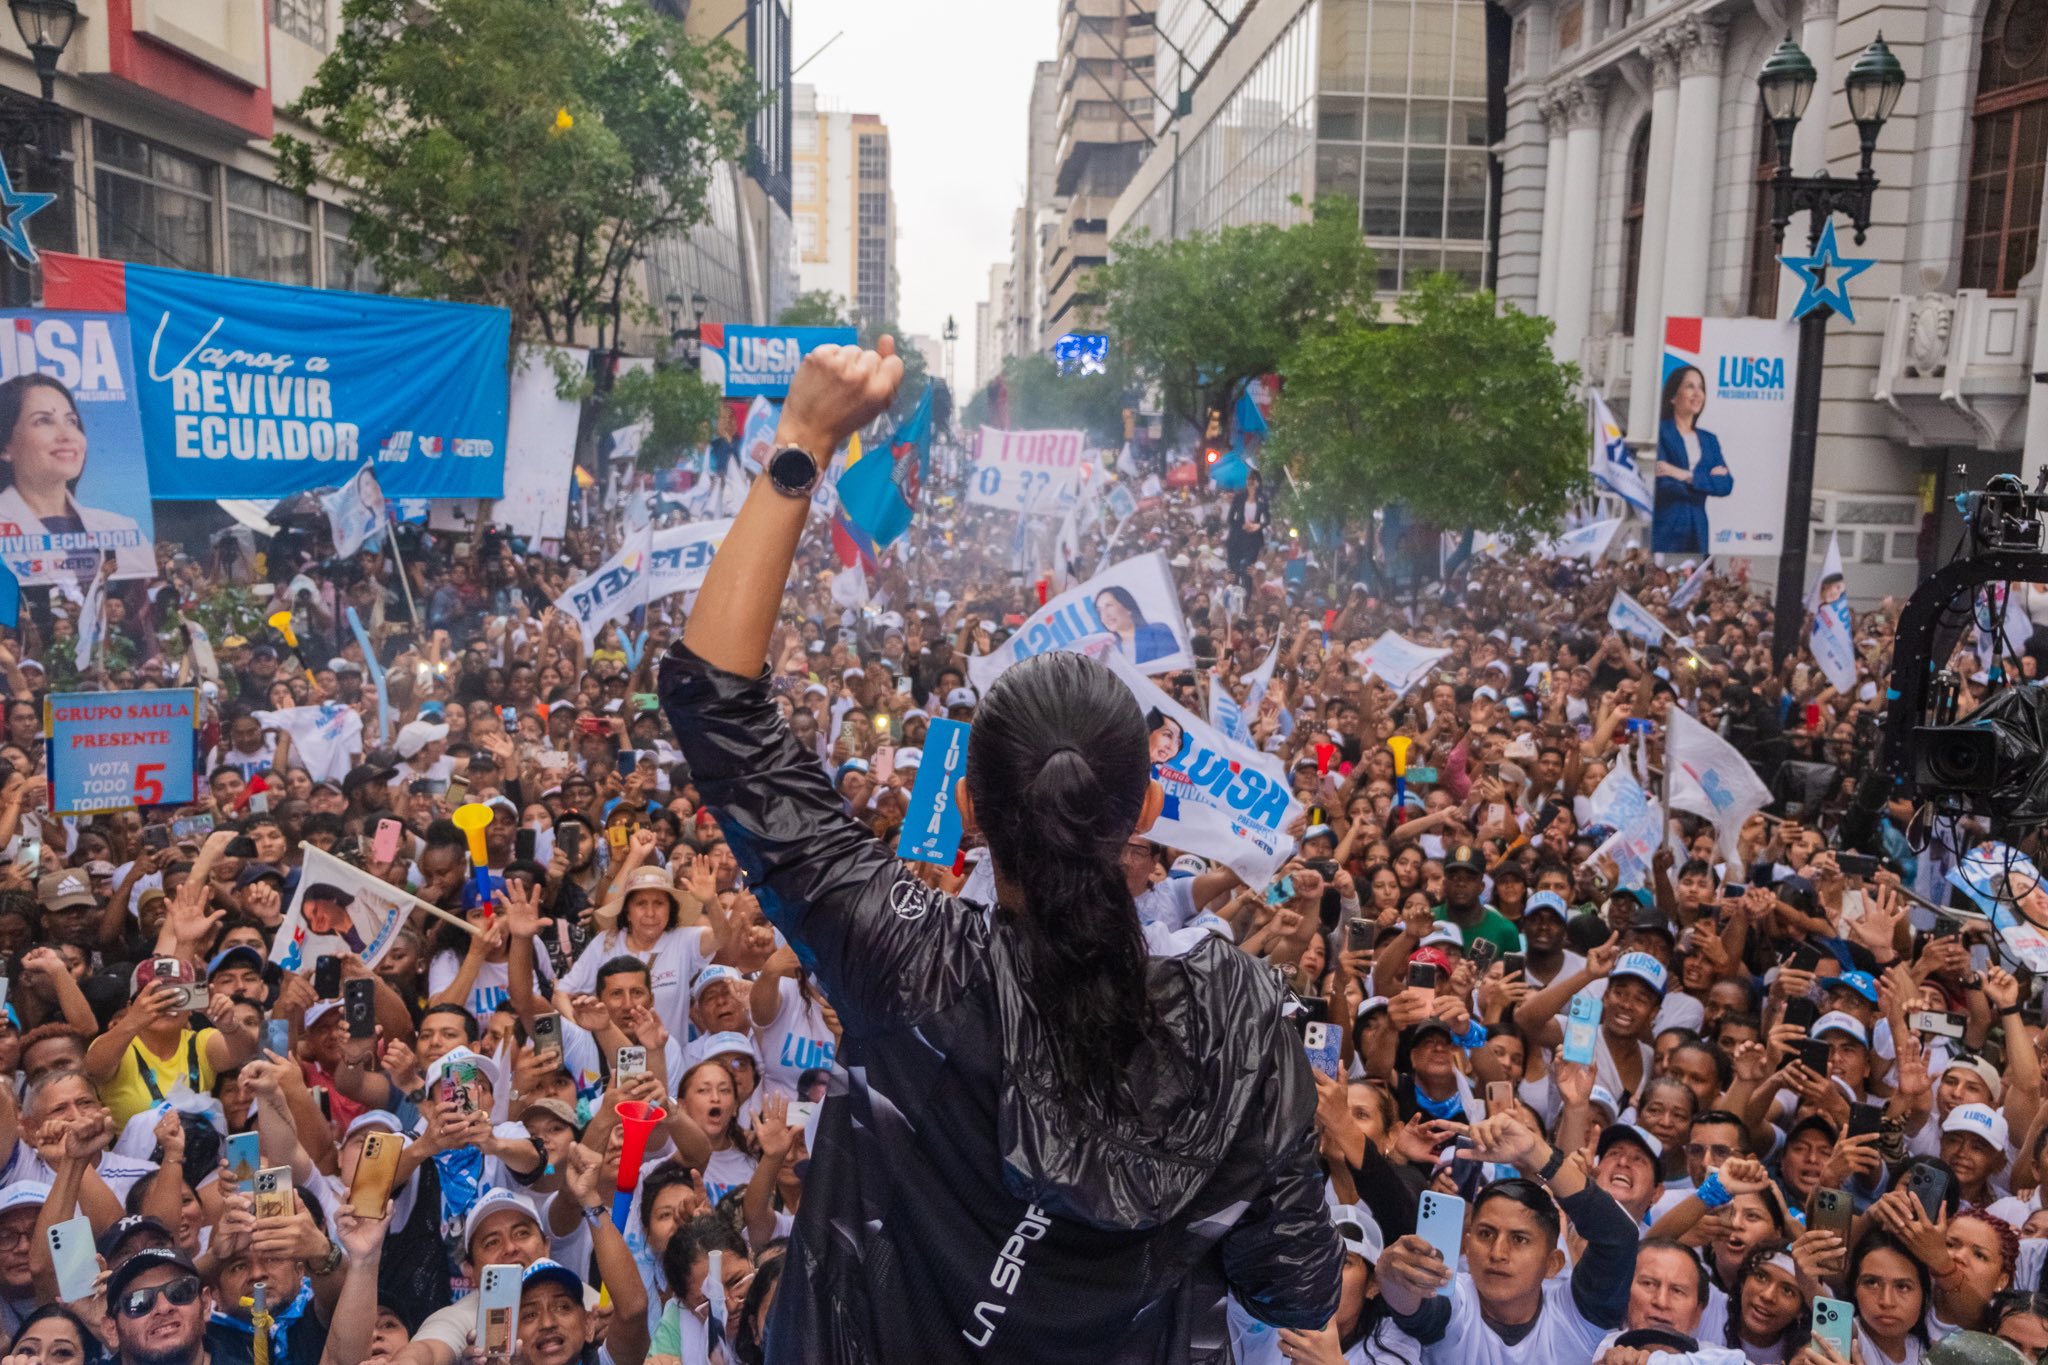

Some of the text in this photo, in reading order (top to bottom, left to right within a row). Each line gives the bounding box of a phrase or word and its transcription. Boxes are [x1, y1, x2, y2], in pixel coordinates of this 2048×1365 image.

[148, 310, 330, 382] Vamos a
[172, 367, 333, 419] REVIVIR
[175, 414, 359, 462] ECUADOR
[52, 528, 140, 550] ECUADOR
[55, 703, 190, 722] GRUPO SAULA
[72, 730, 170, 749] PRESENTE
[88, 761, 129, 777] VOTA
[82, 778, 127, 794] TODO
[133, 763, 166, 805] 5
[72, 795, 130, 812] TODITO
[962, 1301, 1007, 1347] LA
